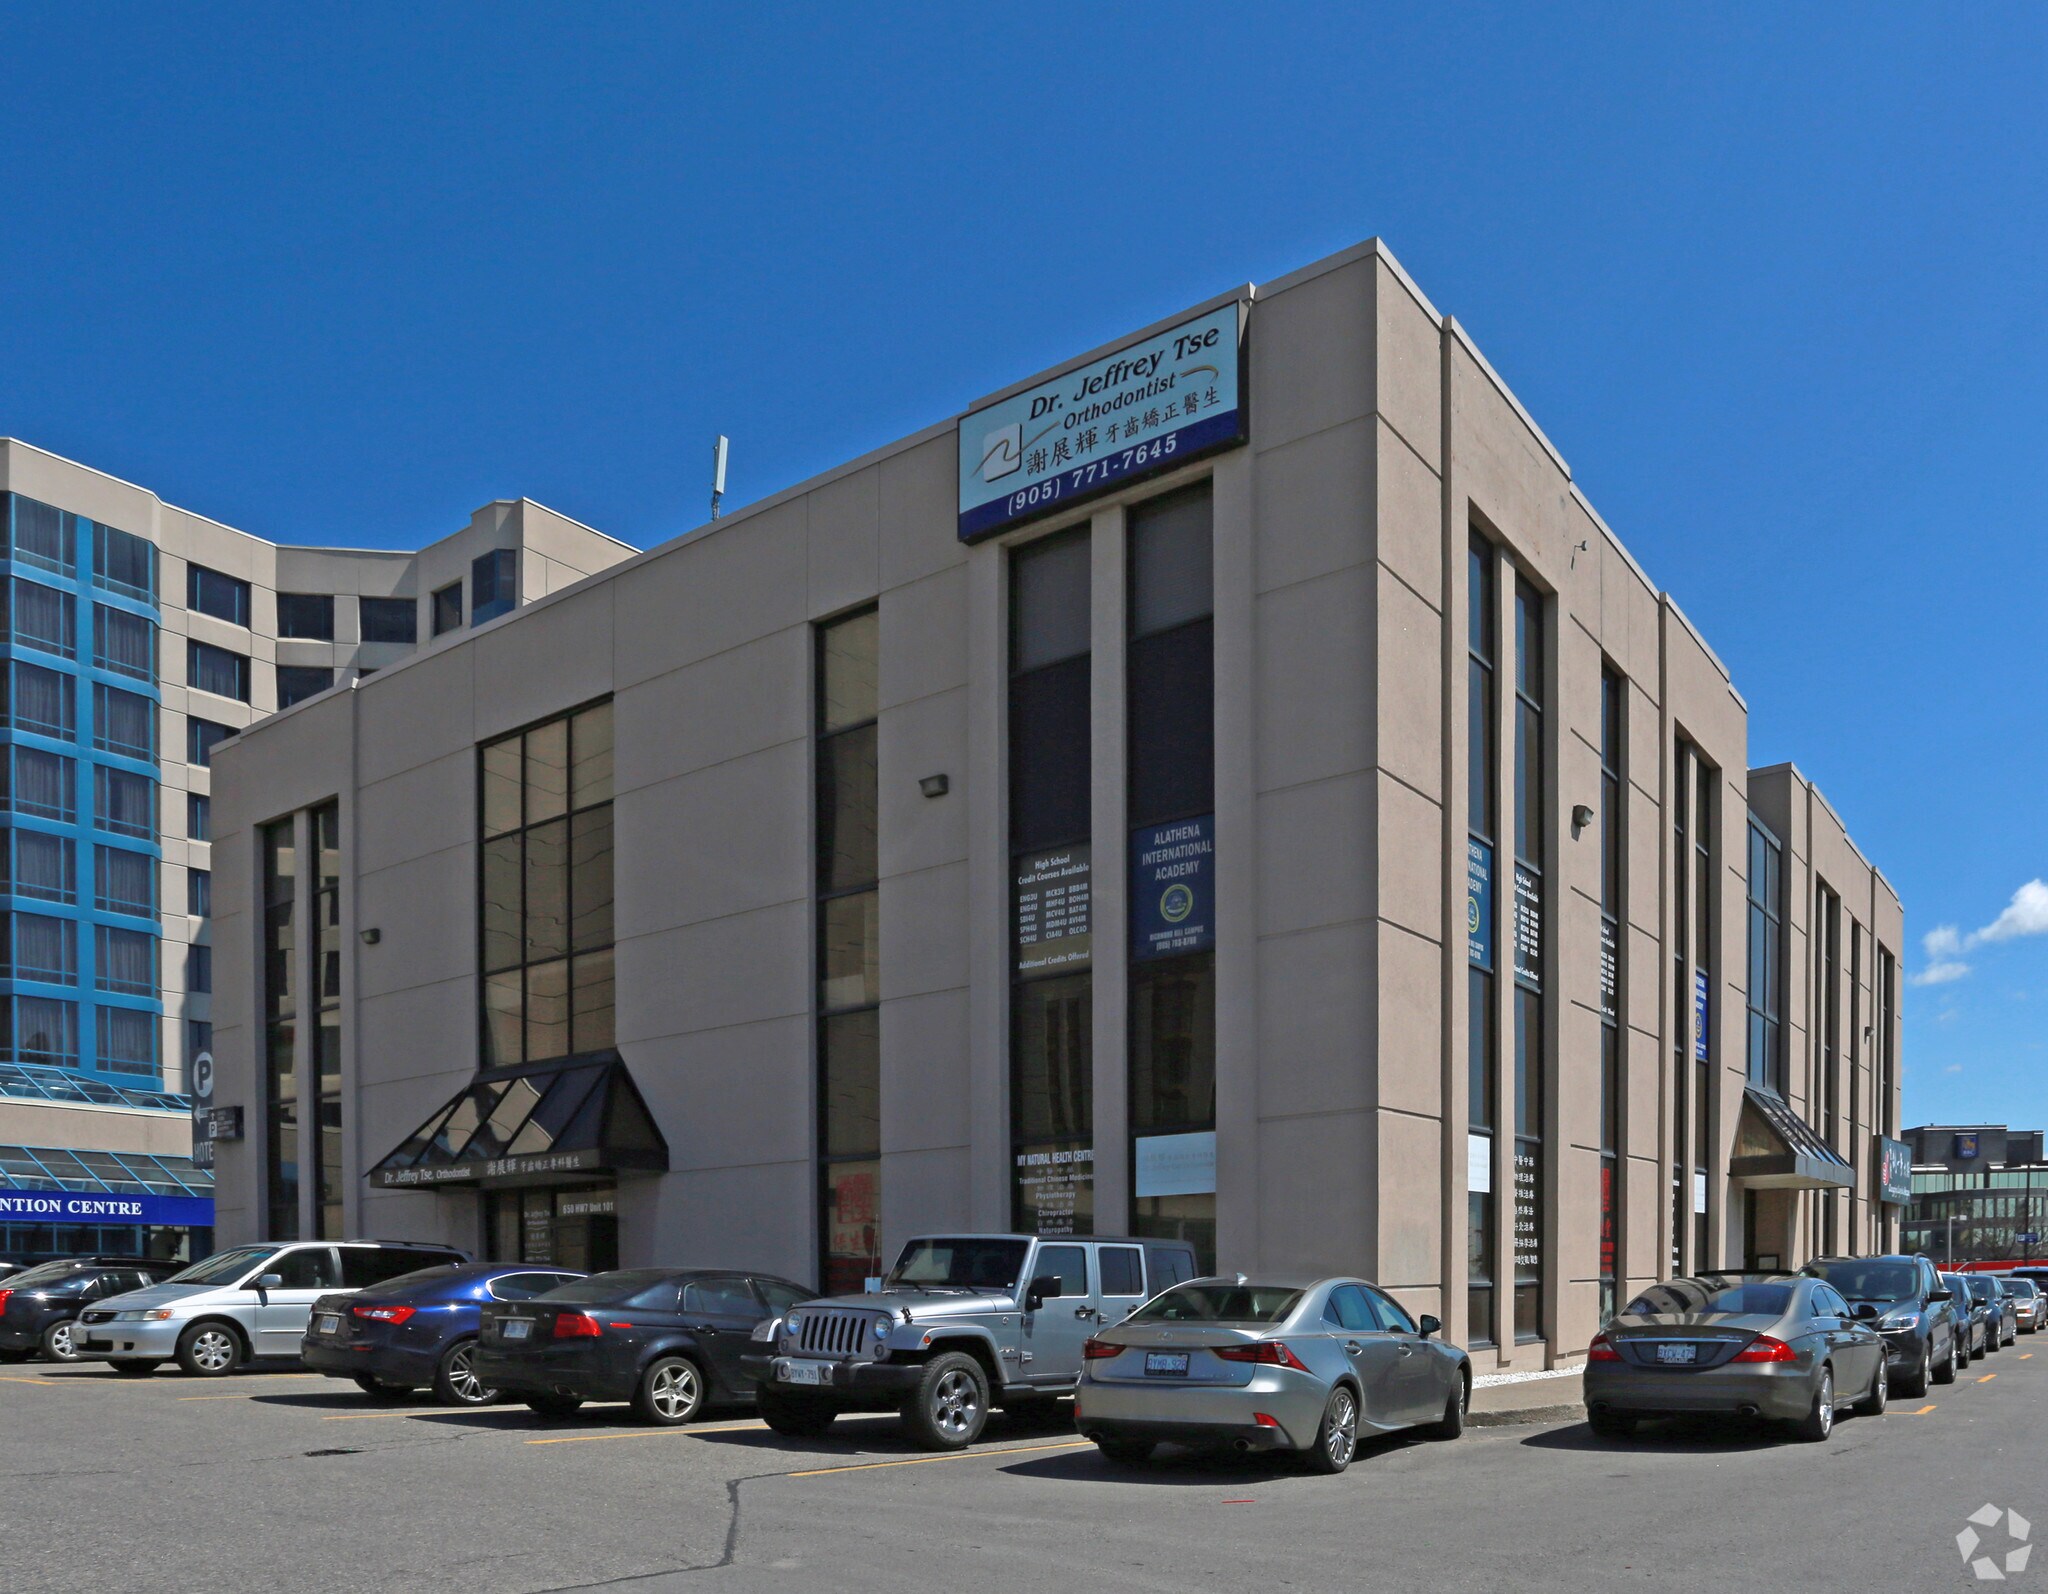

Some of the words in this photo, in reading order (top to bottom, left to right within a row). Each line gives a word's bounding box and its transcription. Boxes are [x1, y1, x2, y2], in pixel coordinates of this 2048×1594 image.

[1029, 395, 1063, 421] Dr.
[1073, 350, 1164, 402] Jeffrey
[1173, 327, 1219, 361] Tse
[1063, 372, 1176, 430] Orthodontist
[1008, 478, 1061, 515] (905)
[1072, 433, 1177, 488] 771-7645
[1154, 824, 1200, 845] ALATHENA
[1142, 840, 1212, 865] INTERNATIONAL
[1035, 859, 1049, 871] High
[1050, 854, 1070, 867] School
[1155, 860, 1200, 880] ACADEMY
[1018, 873, 1036, 885] Credit
[1037, 870, 1060, 881] Courses
[1061, 863, 1089, 877] Available
[1019, 957, 1046, 969] Additional
[1048, 954, 1067, 965] Credits
[1068, 950, 1089, 961] Offered
[198, 1060, 211, 1090] P
[1017, 1155, 1026, 1167] MY
[1027, 1153, 1051, 1166] NATURAL
[1052, 1151, 1073, 1164] HEALTH
[385, 1172, 394, 1183] Dr.
[396, 1169, 418, 1184] Jeffrey
[420, 1168, 434, 1180] Tse,
[436, 1167, 471, 1179] Orthodontist
[1019, 1176, 1046, 1184] Traditional
[1047, 1175, 1068, 1183] Chinese
[1035, 1192, 1076, 1200] Physiotherapy
[0, 1198, 62, 1213] NTION
[67, 1200, 142, 1215] CENTRE
[1038, 1209, 1073, 1217] Chiropractor
[1038, 1226, 1073, 1234] Naturopathy
